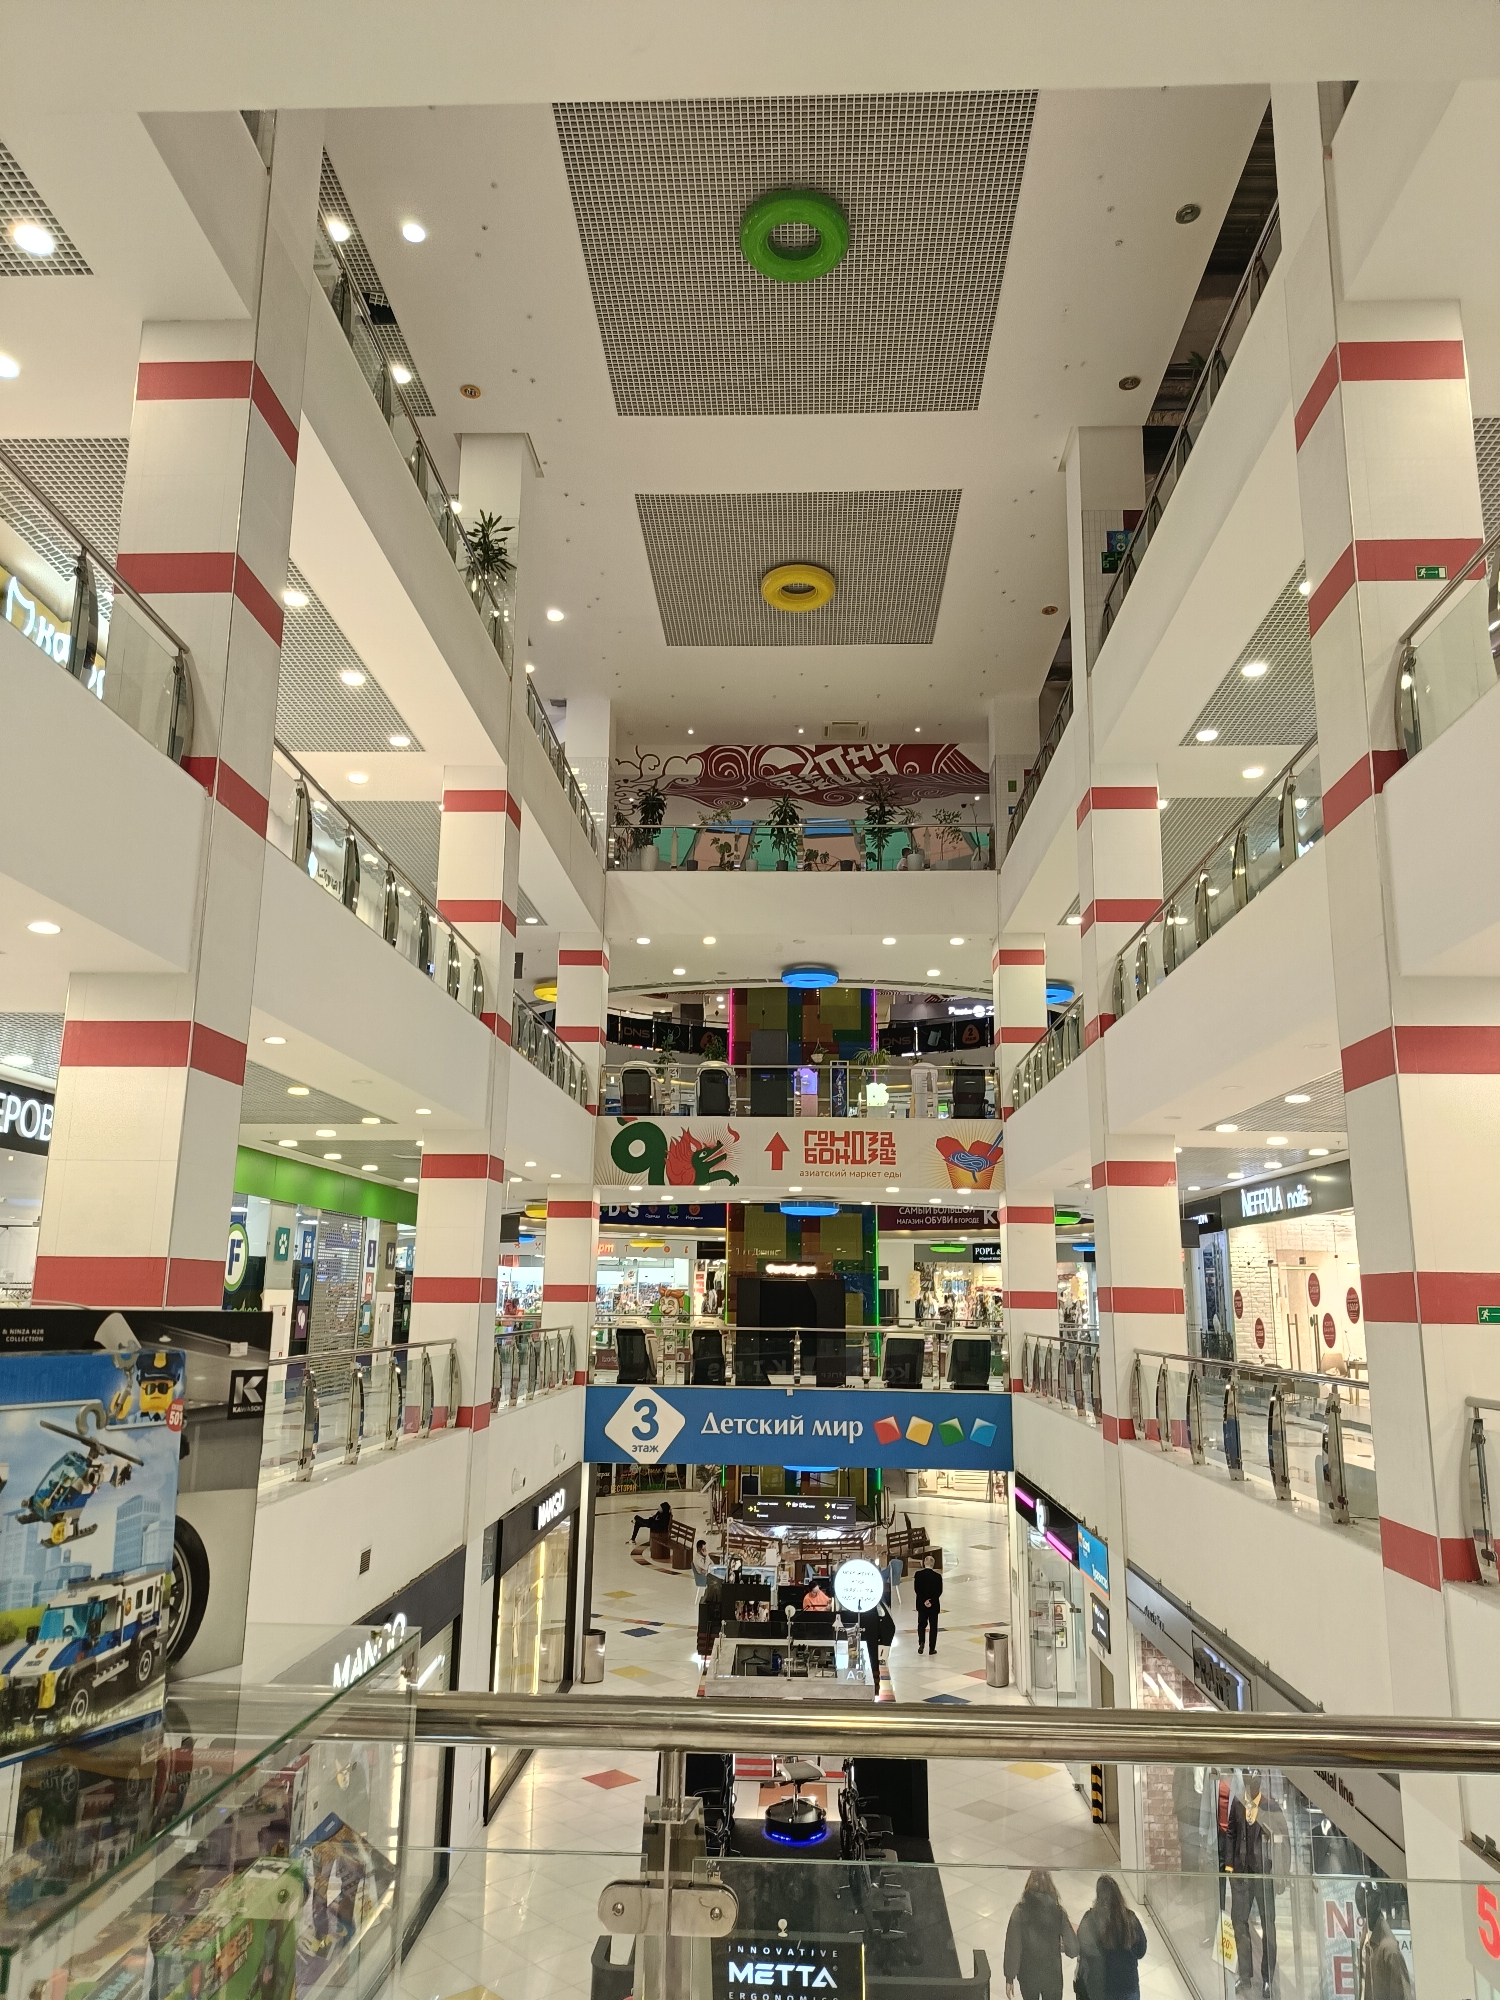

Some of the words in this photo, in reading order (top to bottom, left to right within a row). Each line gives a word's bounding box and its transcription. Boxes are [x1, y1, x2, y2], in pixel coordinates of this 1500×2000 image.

[624, 1027, 651, 1038] DNS
[967, 1027, 974, 1036] 2
[881, 1036, 912, 1046] DNS
[799, 1168, 847, 1178] азиатский
[849, 1170, 882, 1179] маркет
[883, 1170, 902, 1179] еды
[898, 1206, 932, 1215] САМЫЙ
[896, 1217, 924, 1225] МАГАЗИН
[924, 1215, 954, 1225] ОБУВИ
[958, 1216, 980, 1224] ГОРОДЕ
[974, 1247, 996, 1256] POPL
[233, 1375, 264, 1405] K
[632, 1398, 660, 1442] 3
[700, 1411, 805, 1437] Детский
[812, 1419, 864, 1444] мир
[631, 1443, 660, 1454] этаж
[1338, 1776, 1355, 1807] line
[727, 1944, 839, 1959] INNOVATIVE
[727, 1961, 839, 1989] METTA
